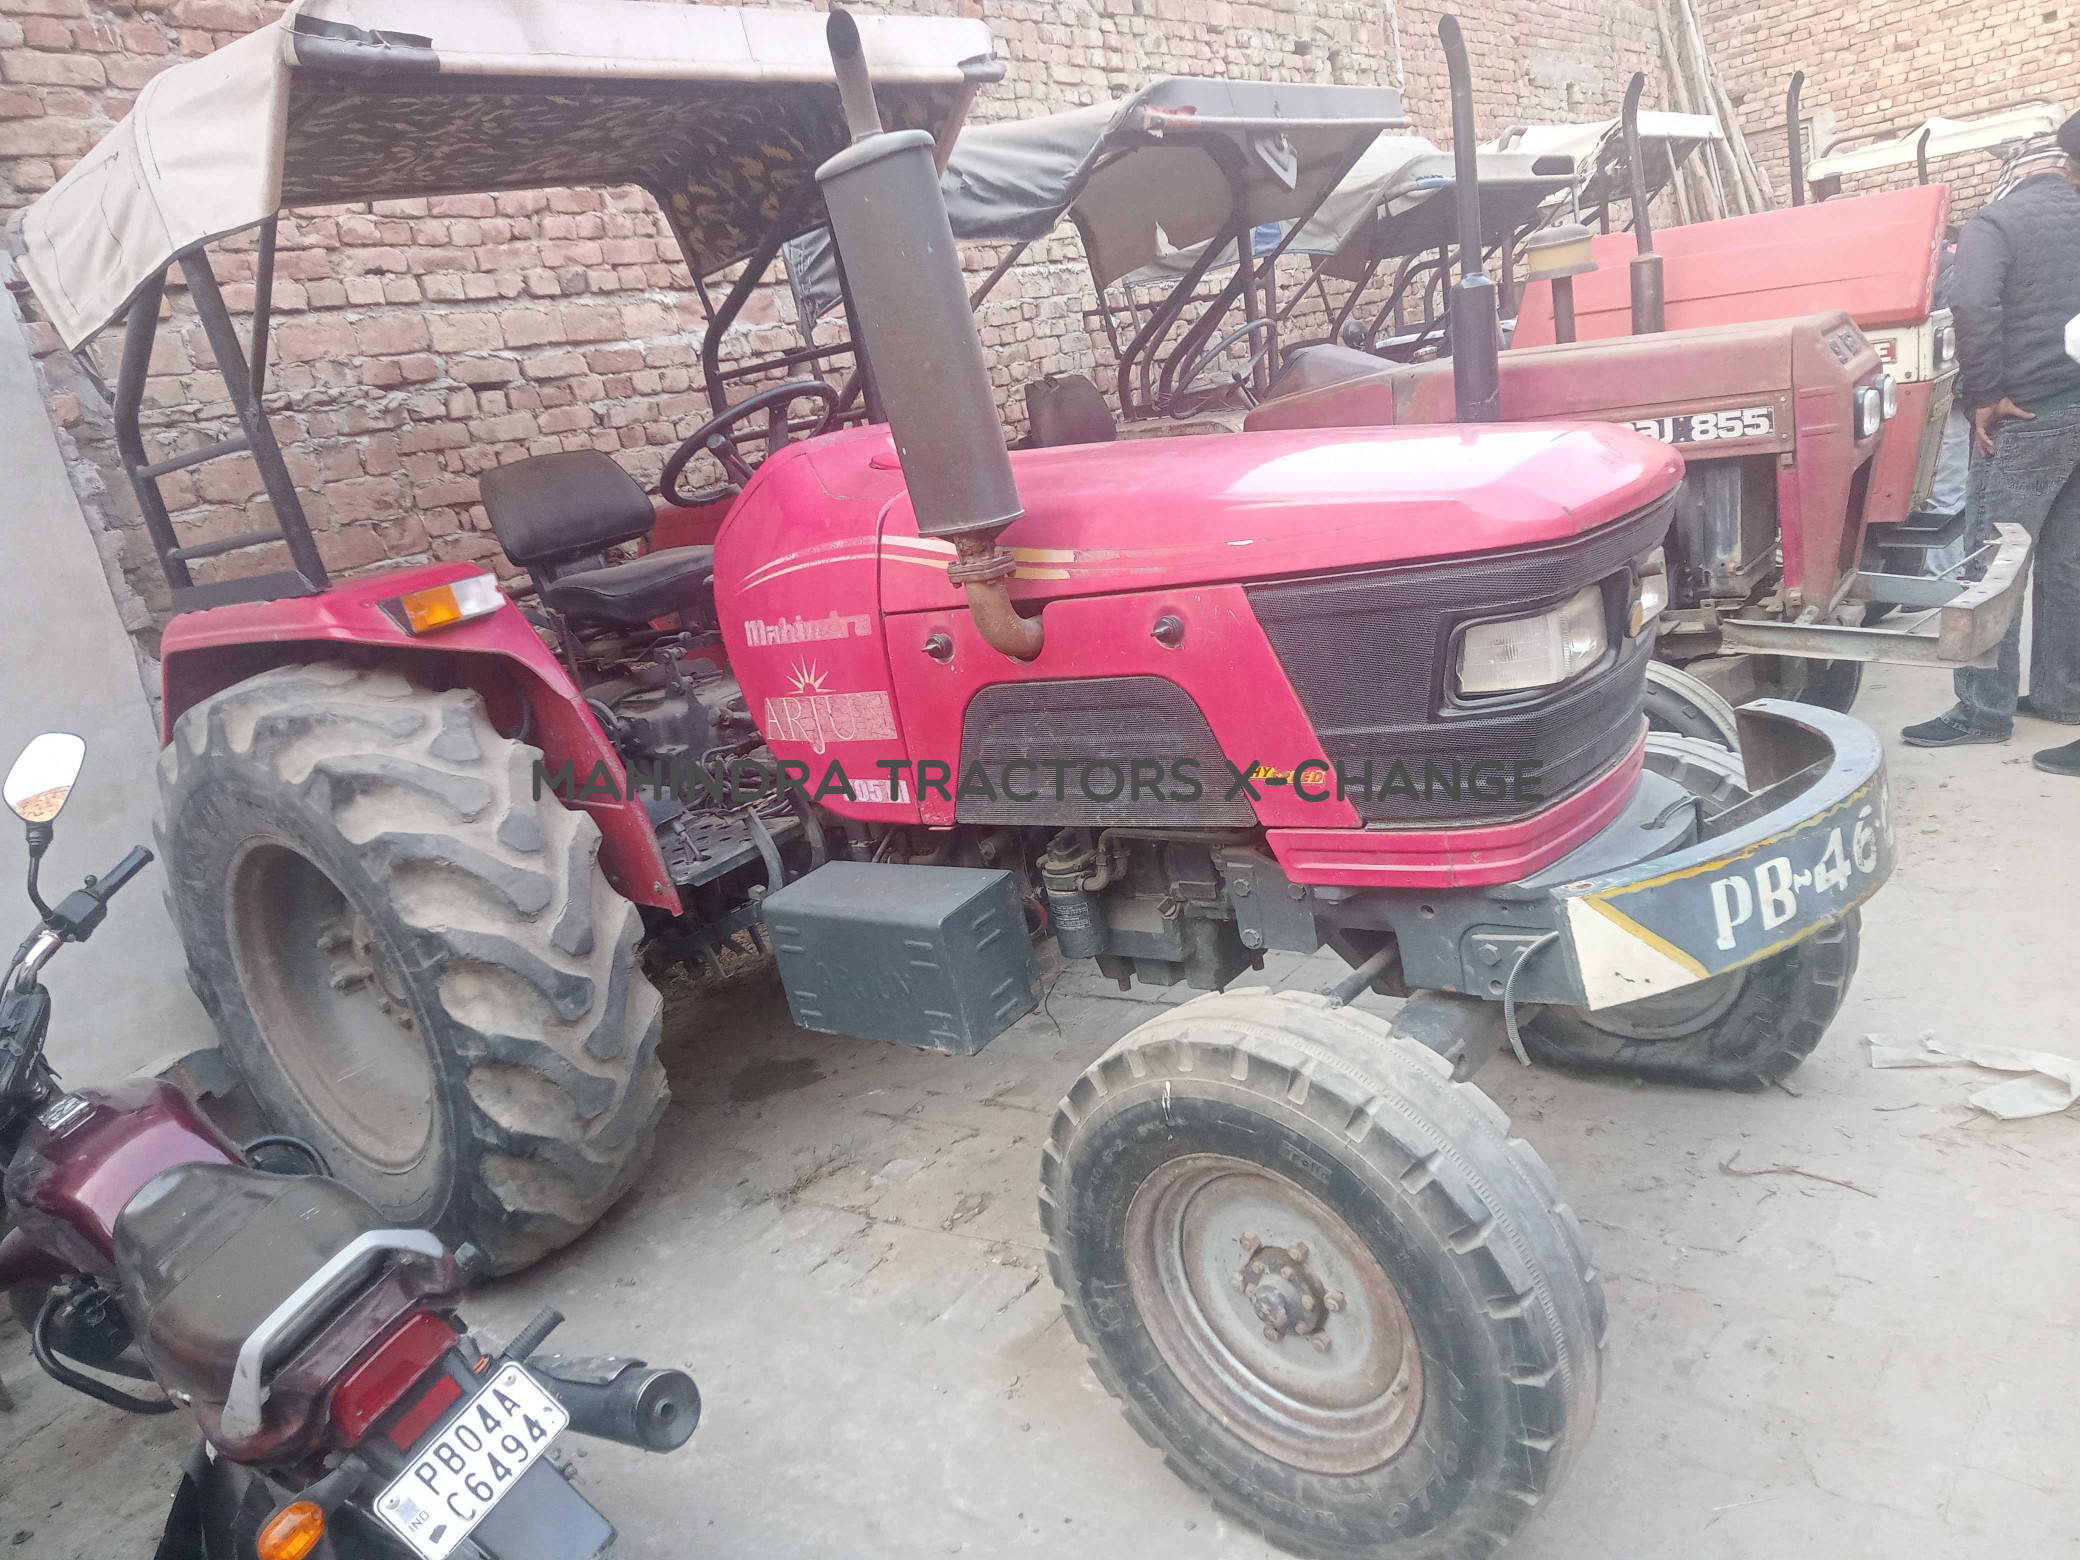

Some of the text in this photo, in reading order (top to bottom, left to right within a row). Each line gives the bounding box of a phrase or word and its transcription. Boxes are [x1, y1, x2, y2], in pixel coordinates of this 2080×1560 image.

[1691, 407, 1770, 442] 855
[413, 1387, 521, 1496] PB04A
[446, 1413, 548, 1522] C6494
[408, 1510, 430, 1533] IND
